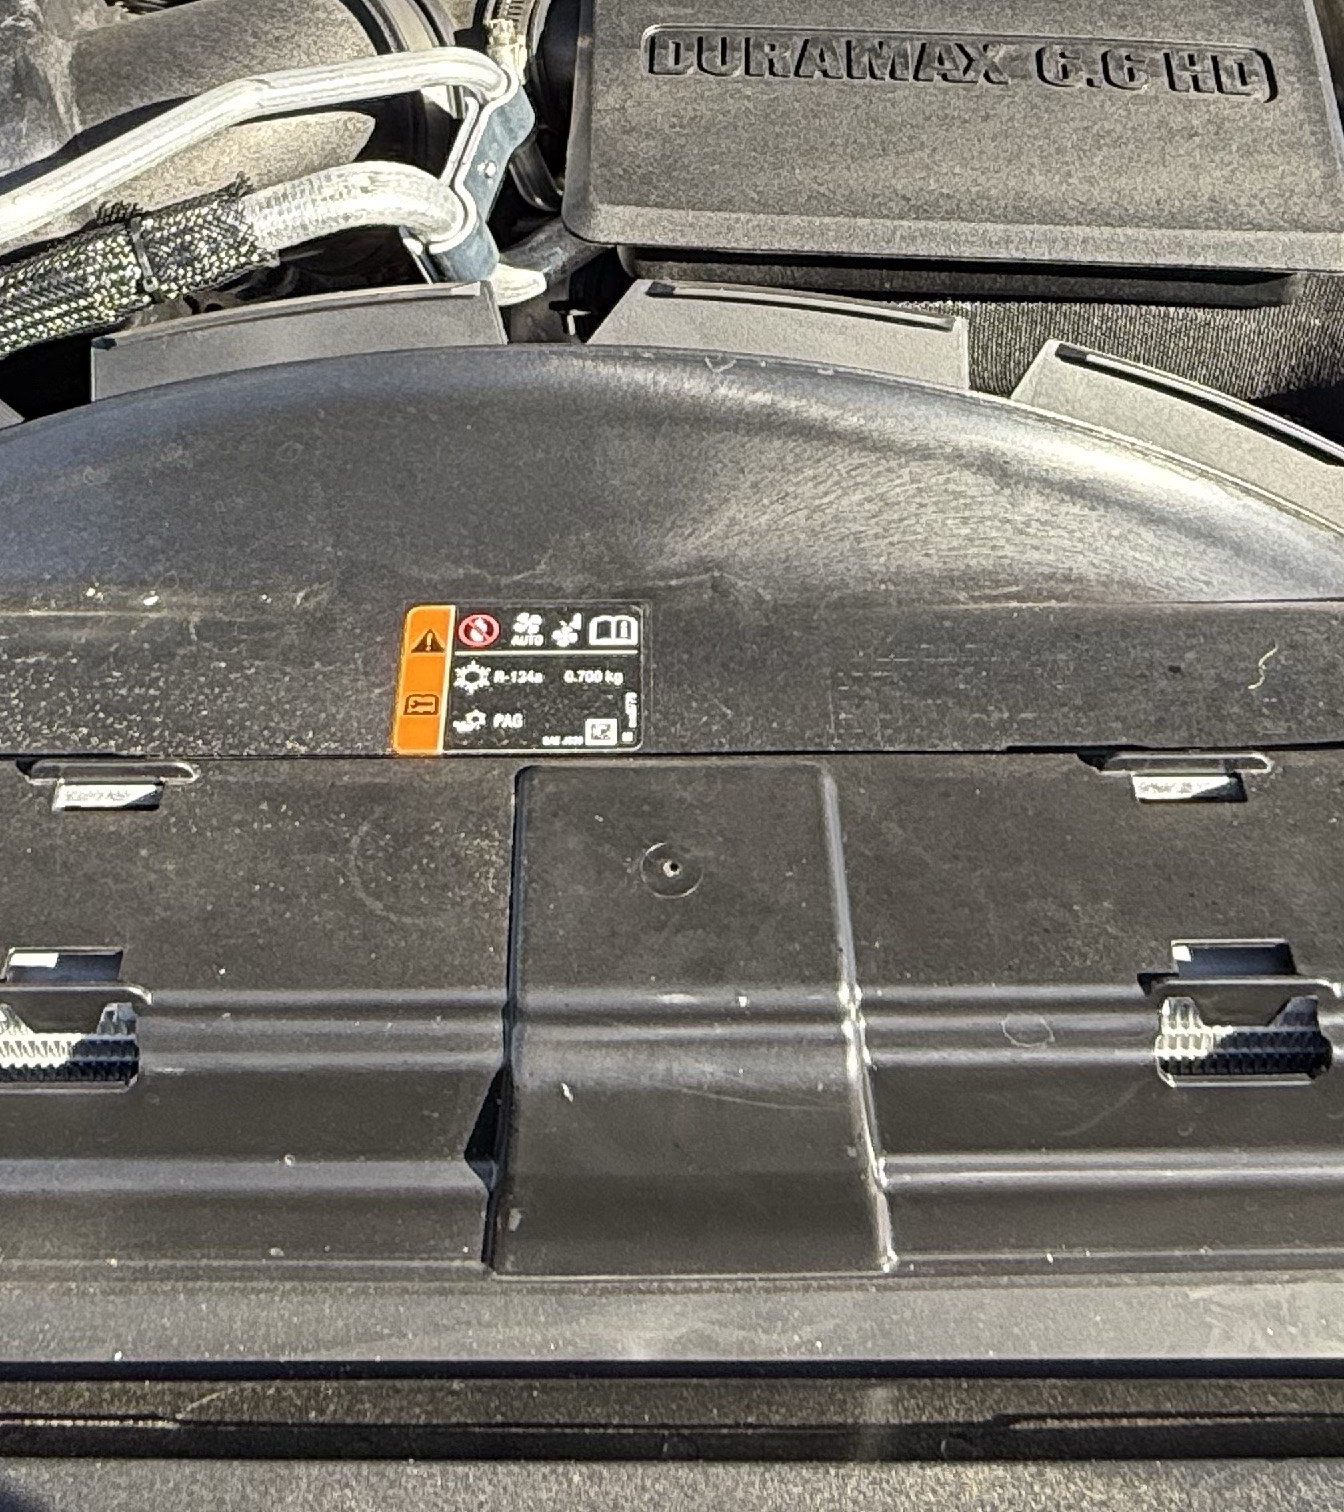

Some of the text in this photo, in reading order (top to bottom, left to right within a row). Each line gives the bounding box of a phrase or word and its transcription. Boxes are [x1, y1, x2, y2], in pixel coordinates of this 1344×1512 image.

[647, 36, 1262, 97] DURAMAX 6.6 HD
[511, 634, 544, 646] AUTO
[604, 670, 624, 686] kg
[492, 713, 524, 729] PAG
